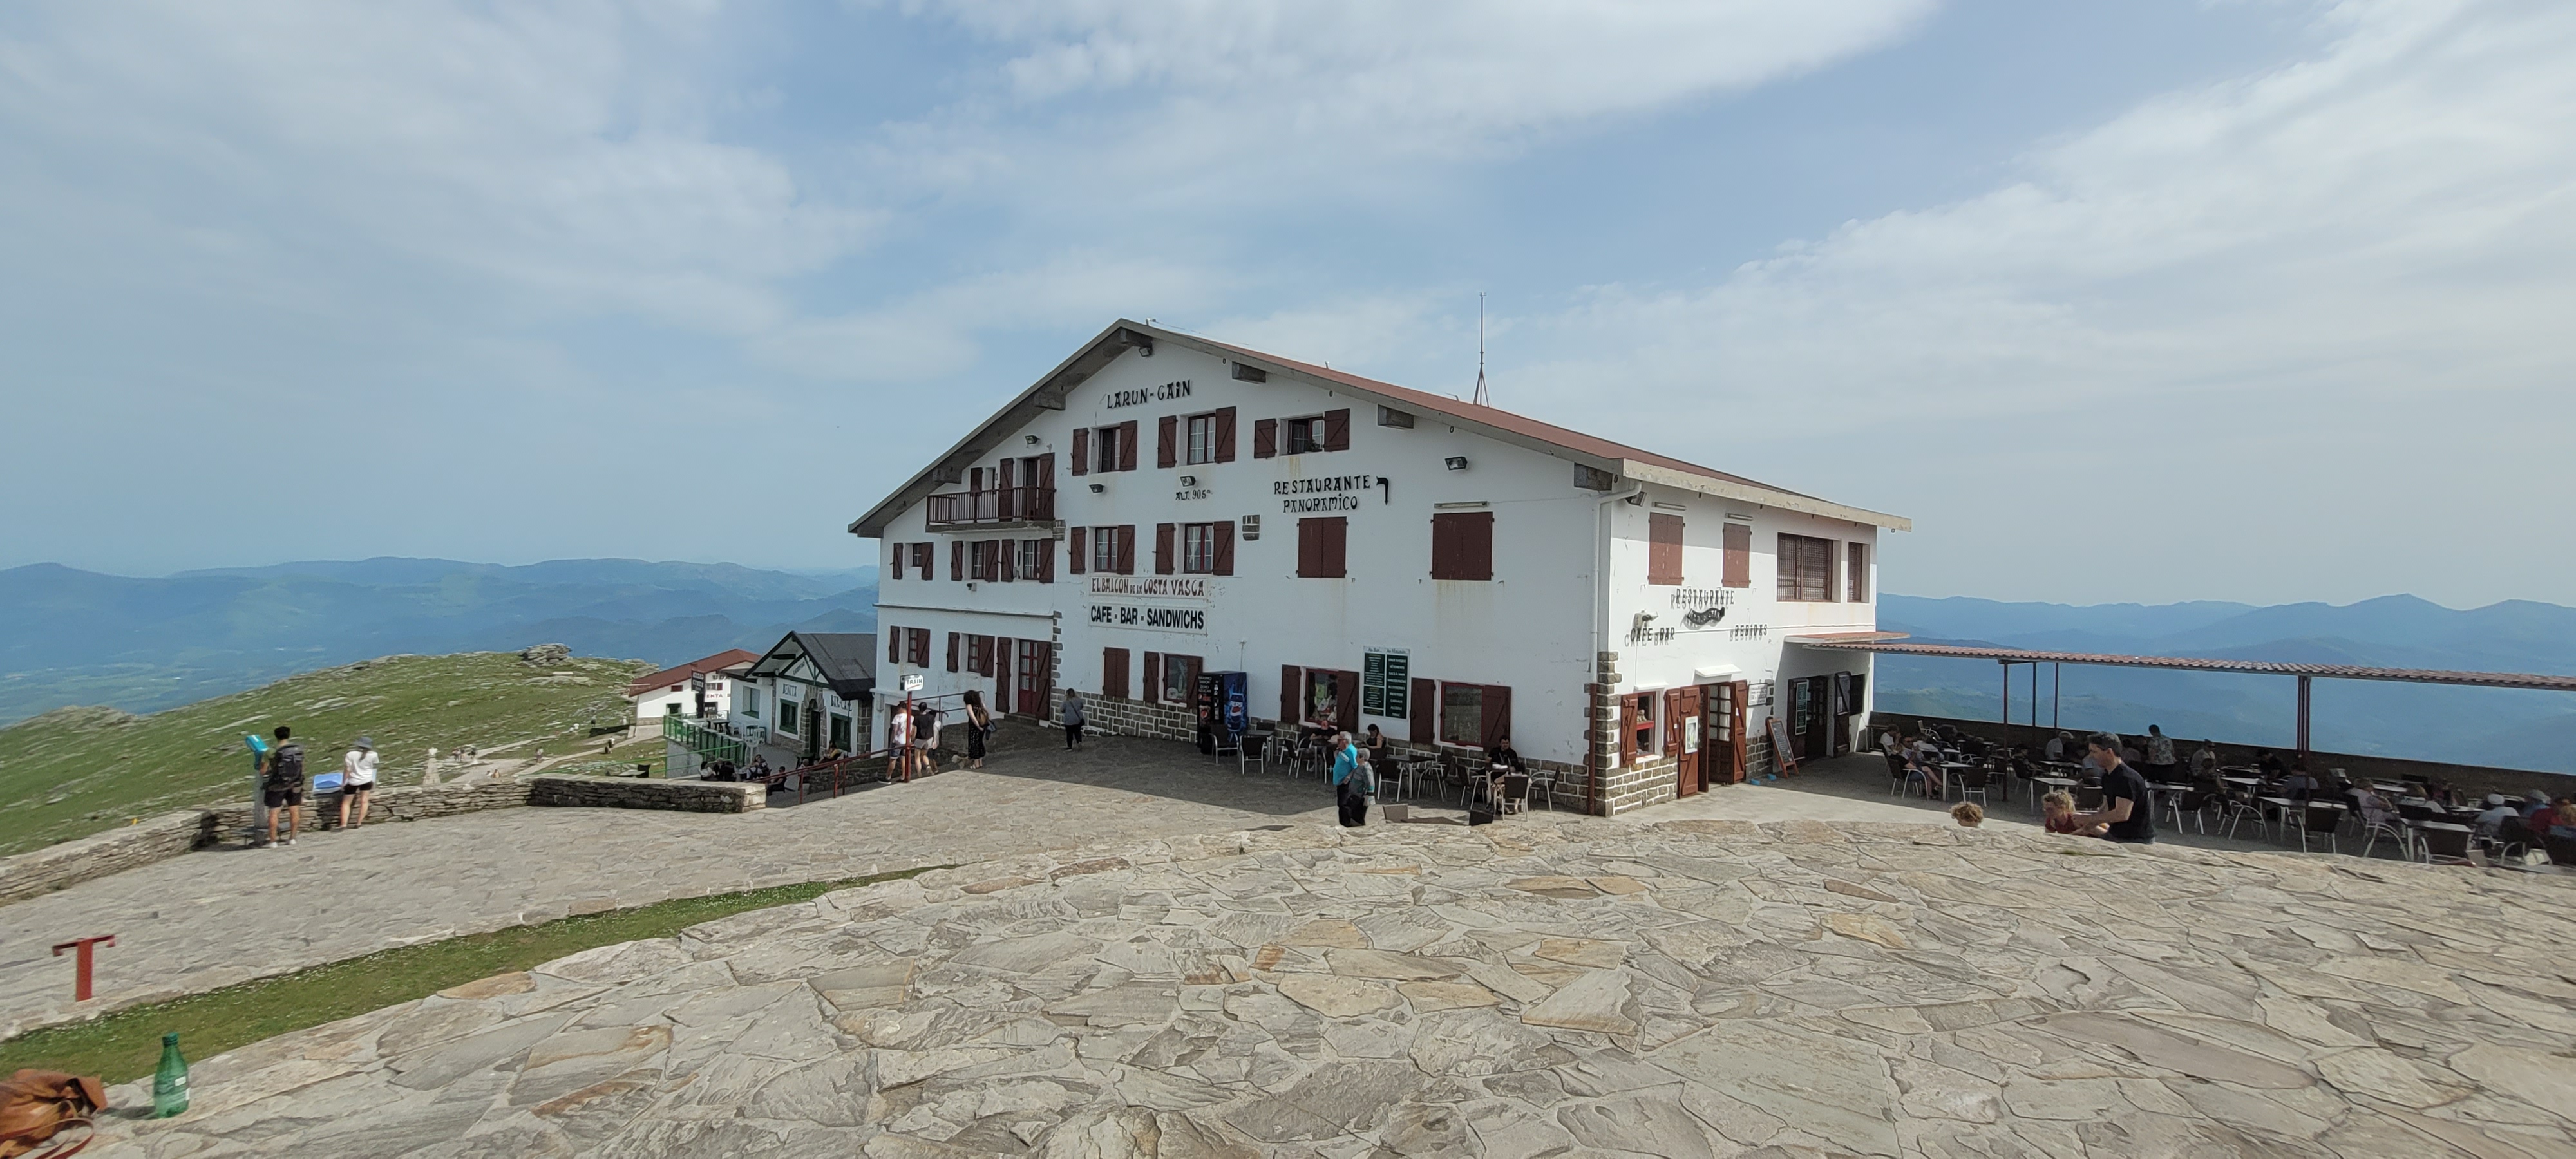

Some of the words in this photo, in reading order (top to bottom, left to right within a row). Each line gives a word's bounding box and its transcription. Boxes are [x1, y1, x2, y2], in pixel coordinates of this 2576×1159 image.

[1274, 475, 1371, 495] RESTAURANTE
[1283, 493, 1358, 513] PANORAMICO
[1092, 578, 1101, 592] EL
[1101, 578, 1129, 594] BALCON
[1144, 579, 1168, 595] COSTA
[1170, 580, 1205, 596] VASCA
[1676, 589, 1734, 605] RESTAURANTE
[1091, 605, 1112, 623] CAFE
[1121, 607, 1138, 625] BAR
[1147, 608, 1204, 630] SANDWICHS
[1735, 624, 1768, 637] BEBIDAS
